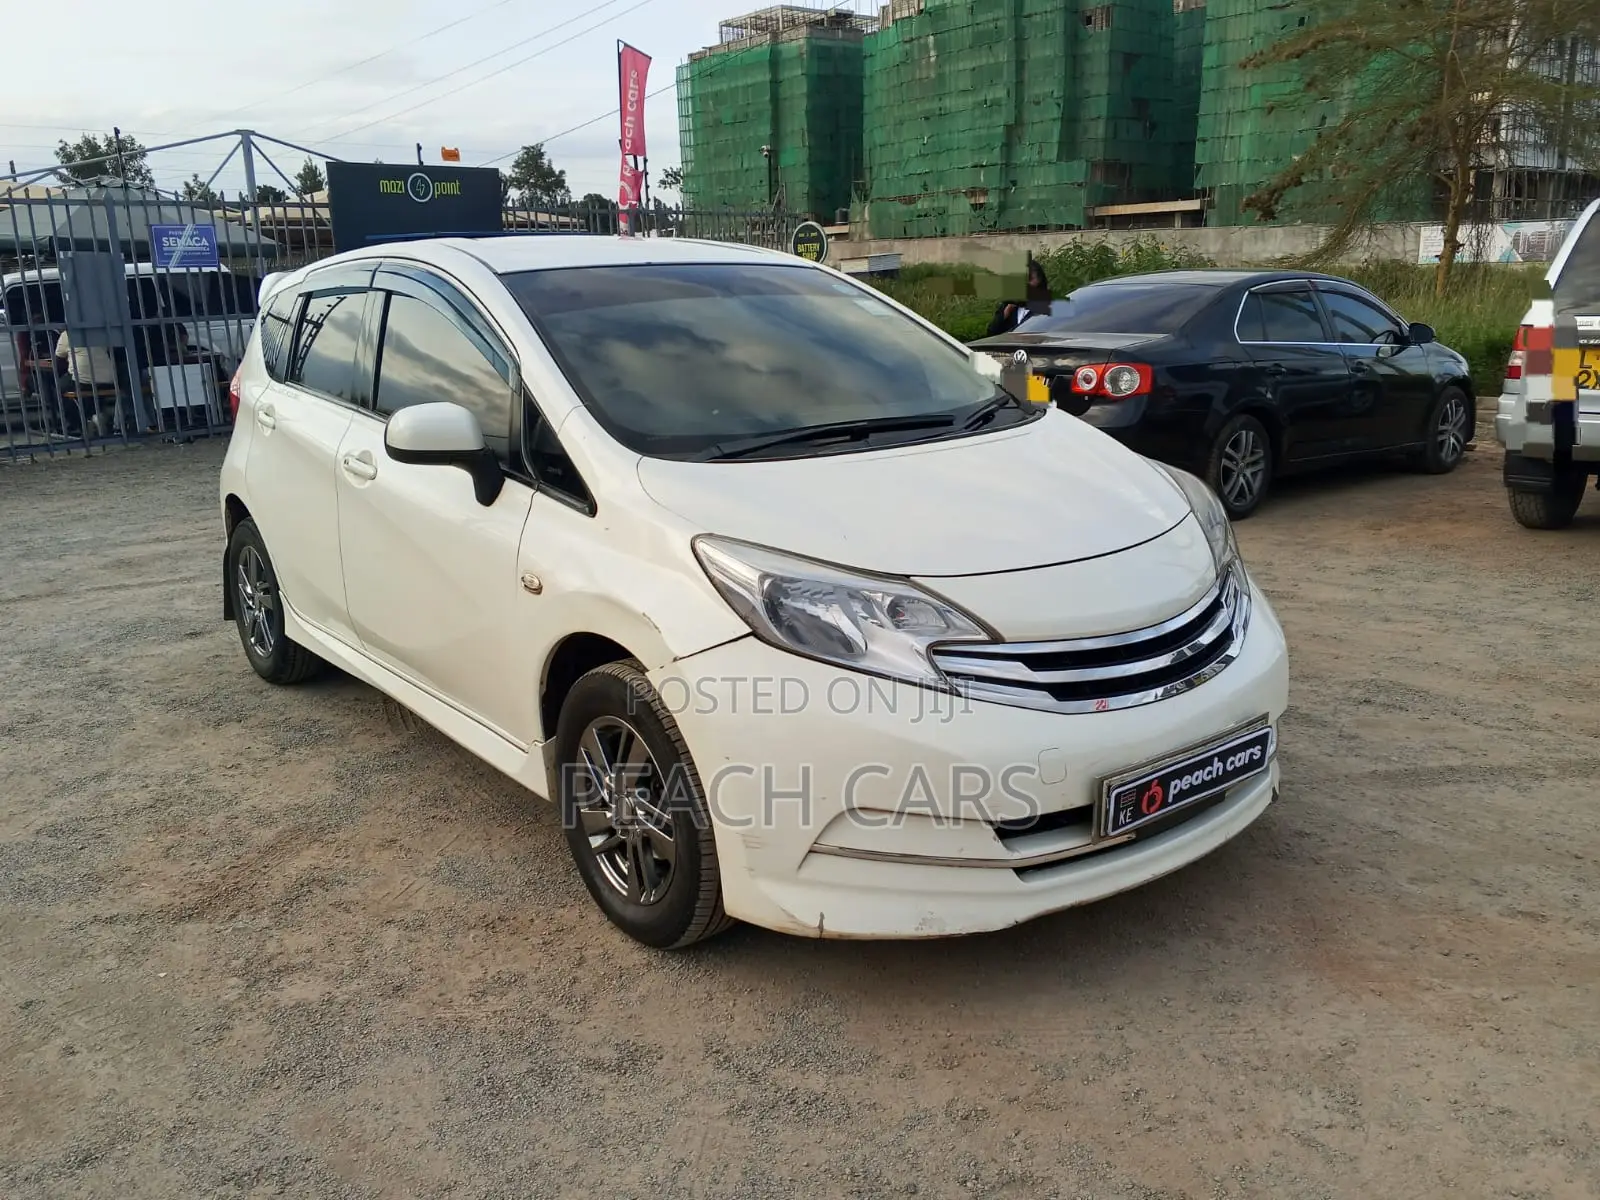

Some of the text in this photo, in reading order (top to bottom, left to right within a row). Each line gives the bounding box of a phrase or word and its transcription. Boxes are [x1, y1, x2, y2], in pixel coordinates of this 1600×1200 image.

[627, 69, 640, 111] cars
[379, 179, 461, 199] mazi point
[797, 243, 820, 253] BATTERY
[1167, 745, 1263, 804] peach cars
[1118, 806, 1134, 827] KE
